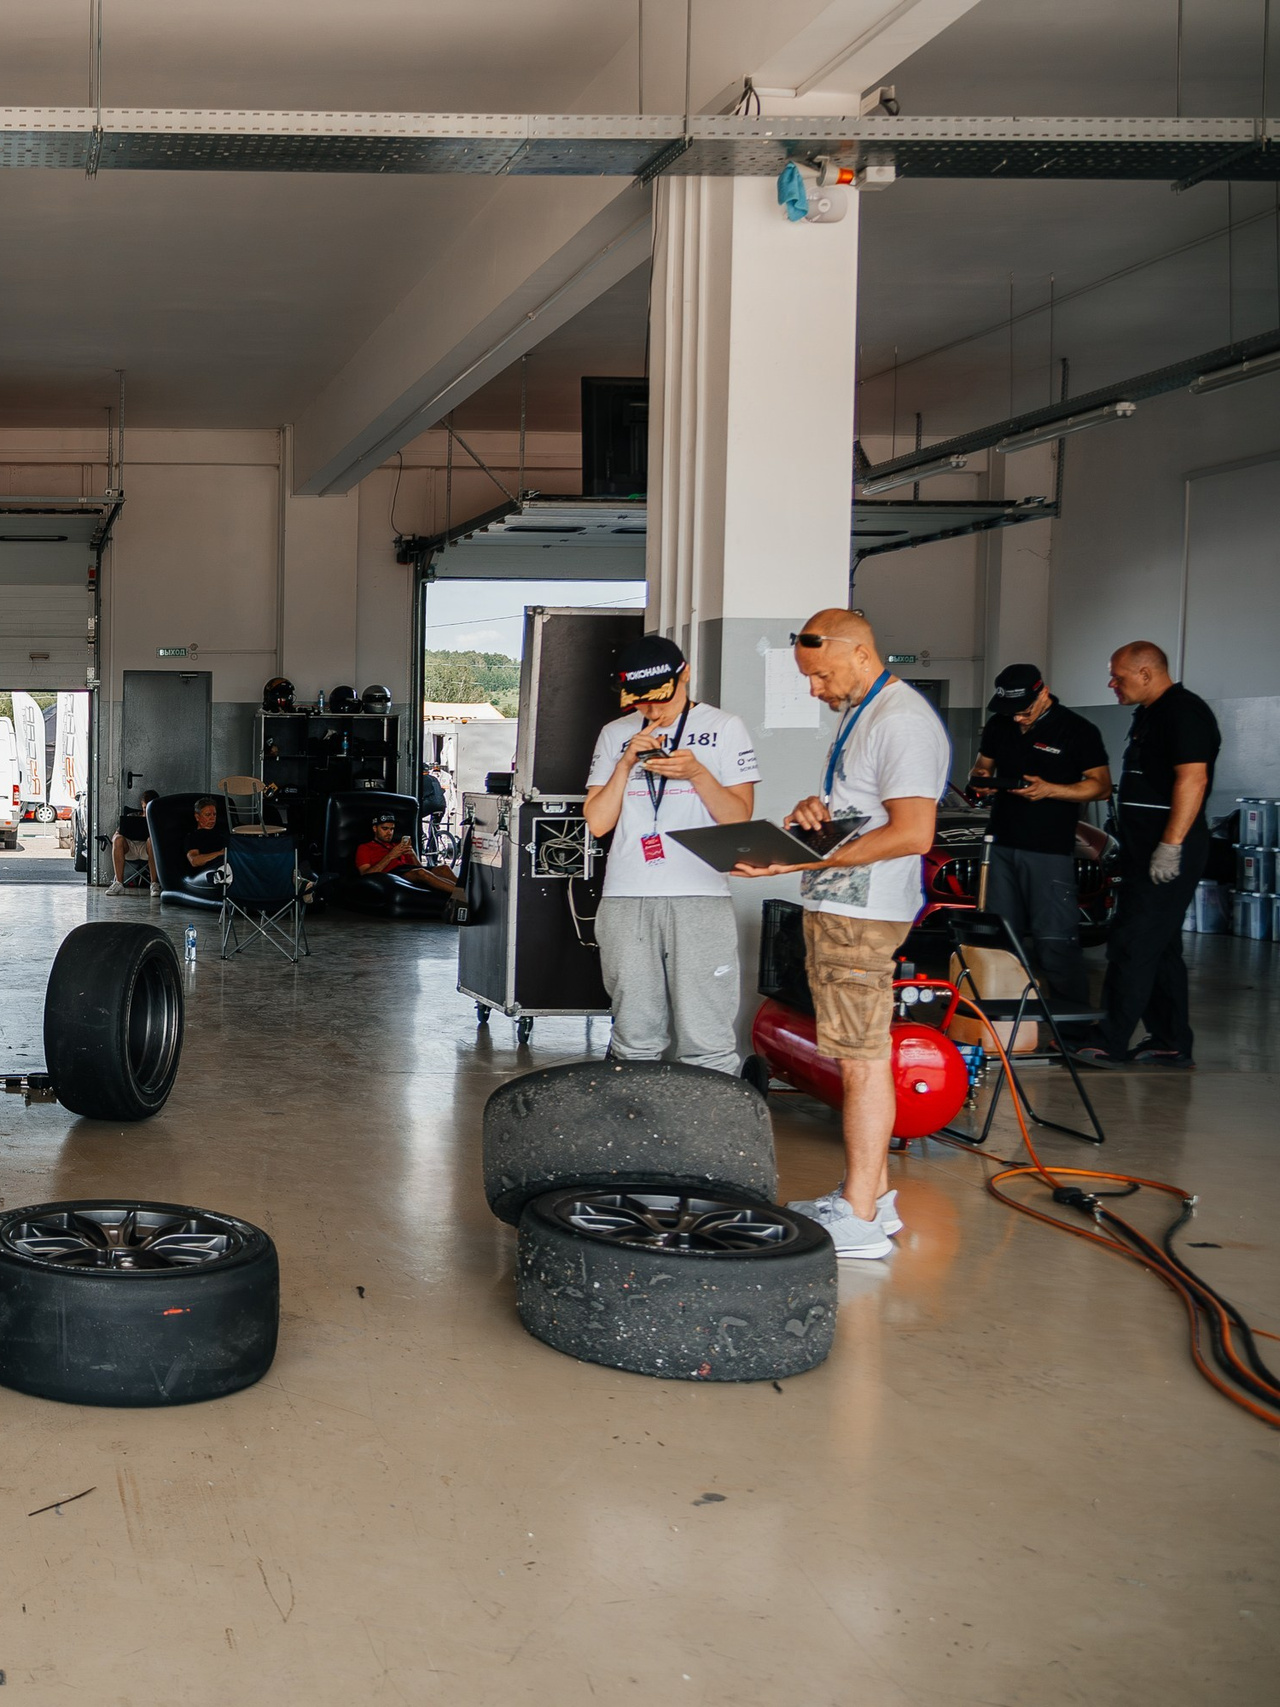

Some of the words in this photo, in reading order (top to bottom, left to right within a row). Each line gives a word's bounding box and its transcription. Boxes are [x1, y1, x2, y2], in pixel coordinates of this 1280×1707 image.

[888, 655, 914, 663] ВЫХОД
[625, 663, 672, 681] YOKOHAMA
[686, 732, 718, 748] 18!
